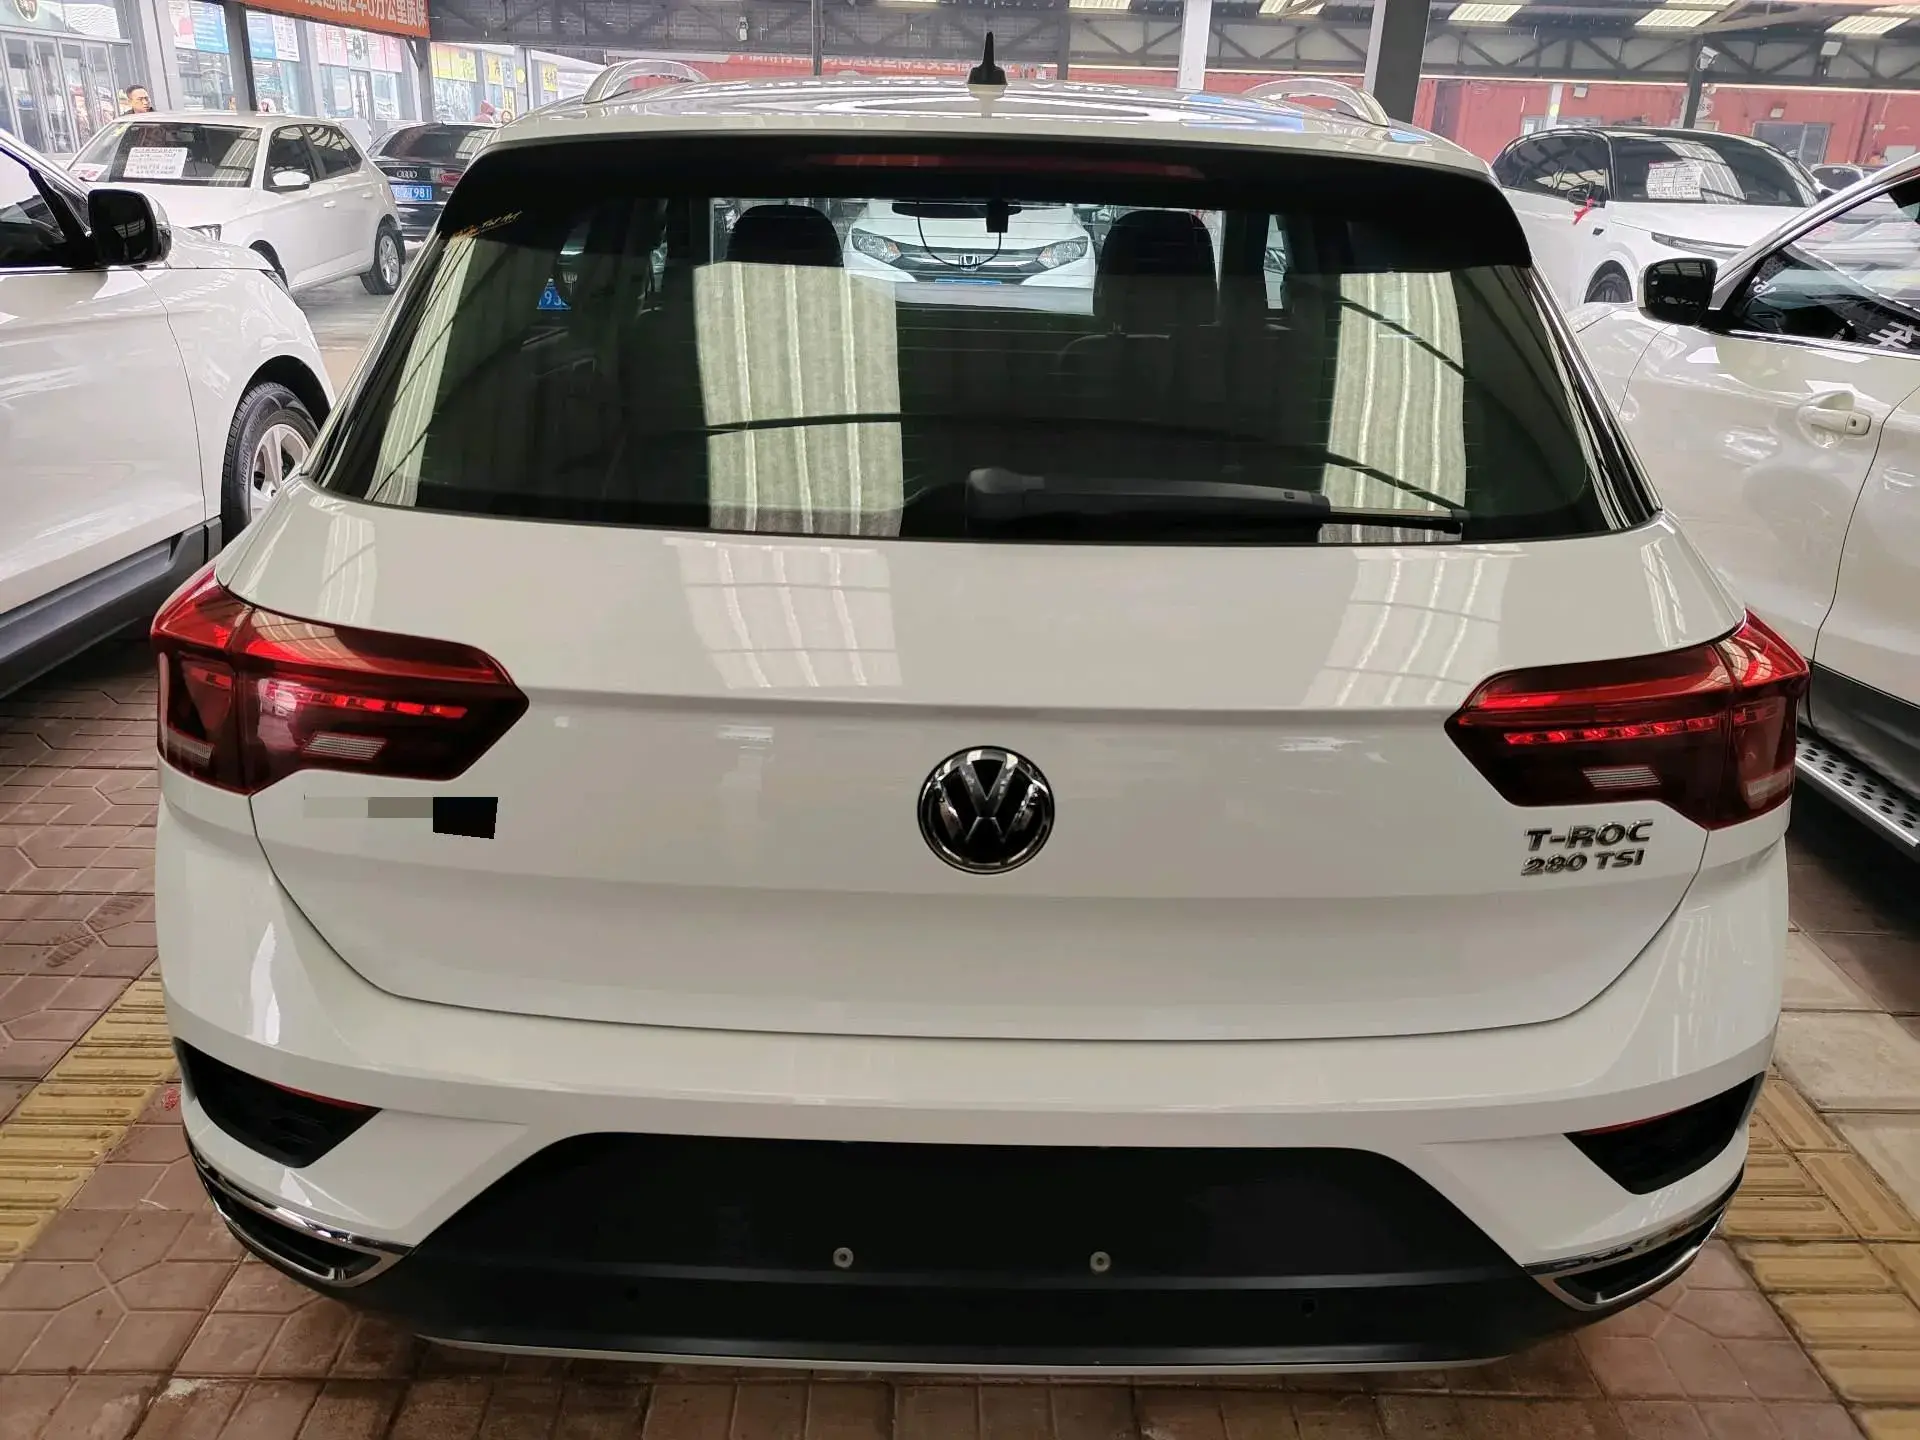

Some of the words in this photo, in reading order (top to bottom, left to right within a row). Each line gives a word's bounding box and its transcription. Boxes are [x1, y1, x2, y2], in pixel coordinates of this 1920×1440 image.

[1524, 819, 1654, 852] T-ROC
[1521, 852, 1588, 876] 280
[1594, 848, 1645, 869] TSI
